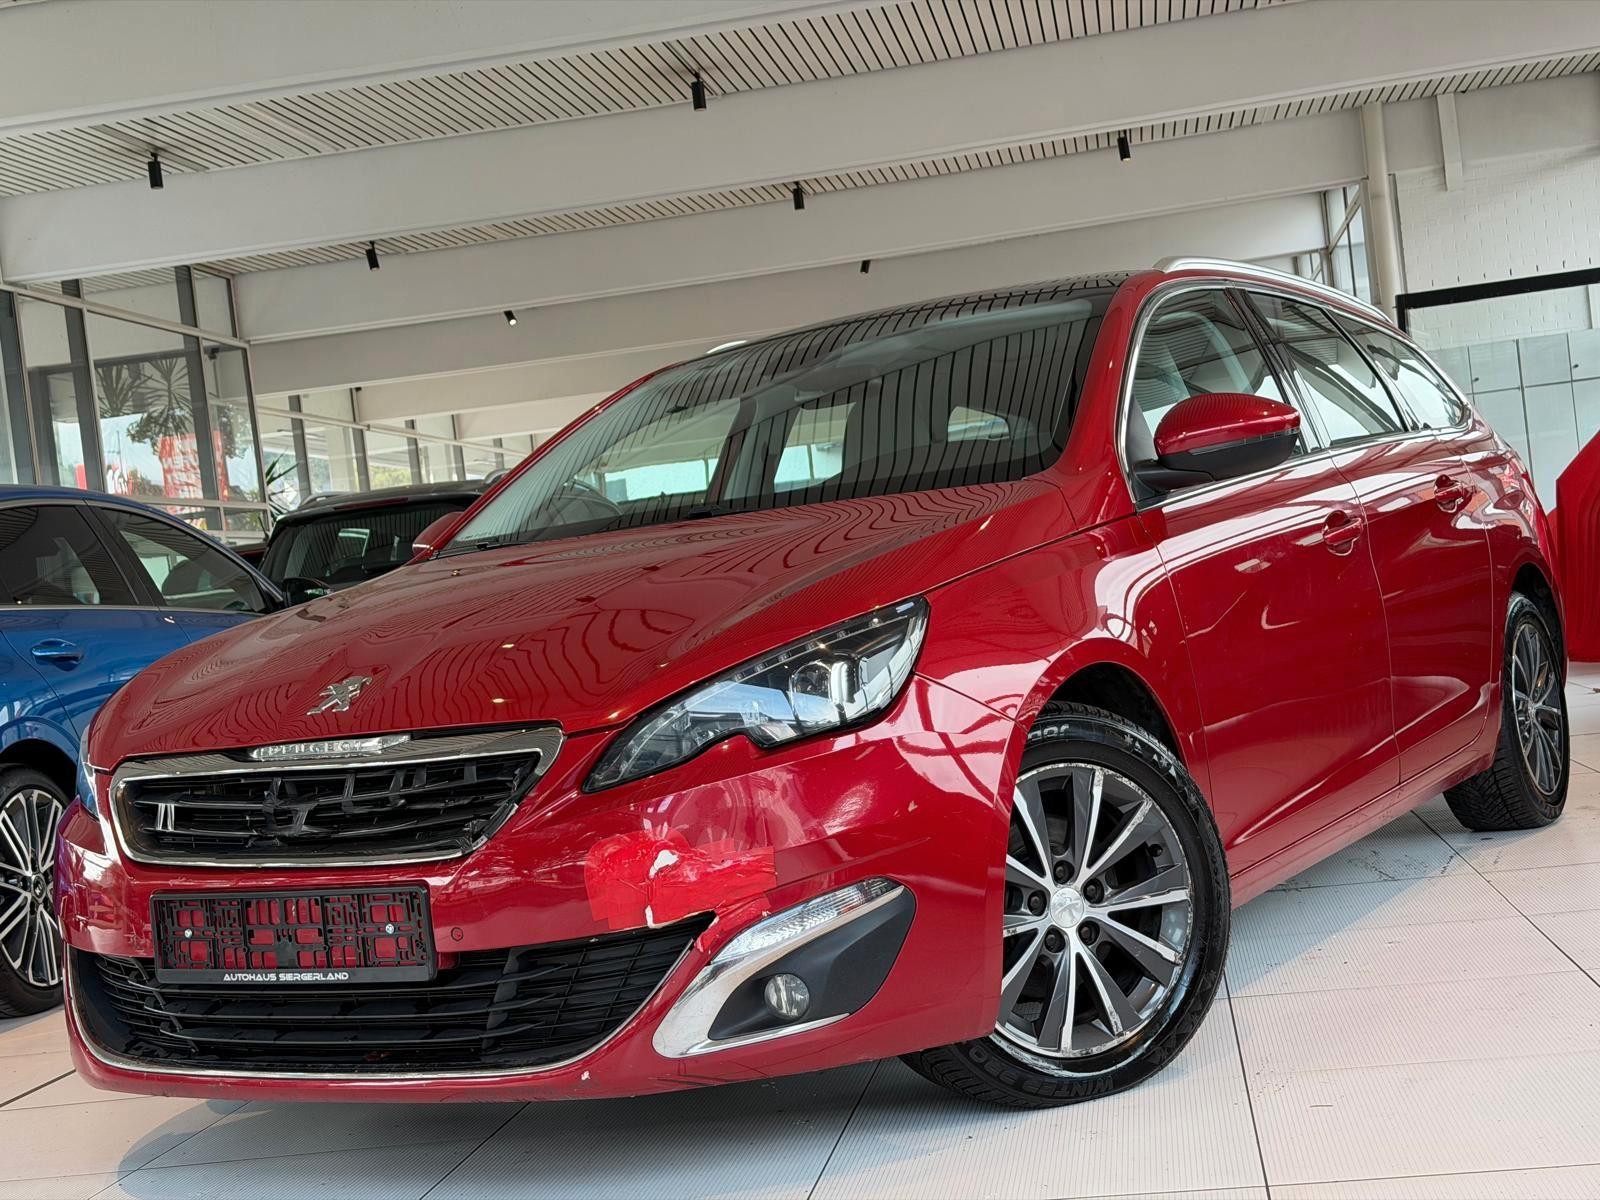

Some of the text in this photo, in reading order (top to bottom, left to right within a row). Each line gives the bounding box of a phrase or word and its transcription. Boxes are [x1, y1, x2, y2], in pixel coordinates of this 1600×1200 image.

[223, 972, 349, 982] AUTOHAUS SIERGERLAND
[968, 1045, 1114, 1097] WINTER PRO
